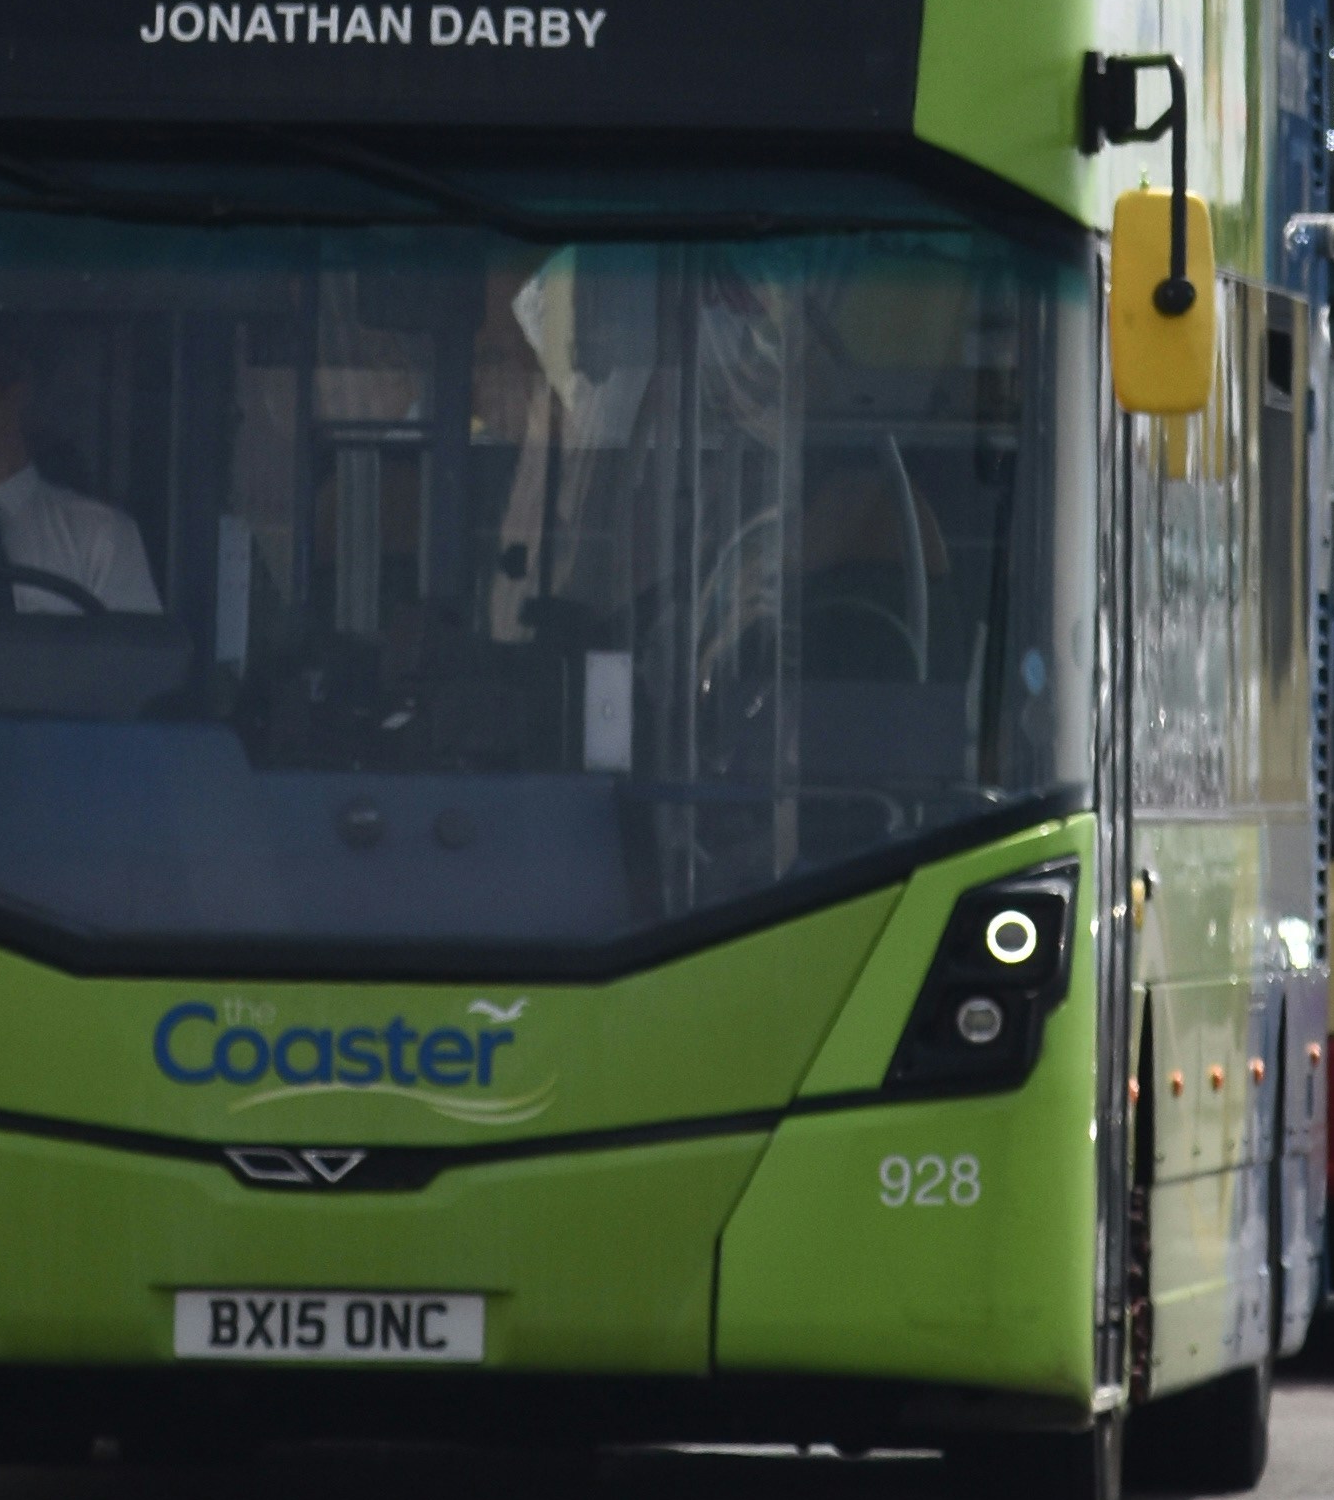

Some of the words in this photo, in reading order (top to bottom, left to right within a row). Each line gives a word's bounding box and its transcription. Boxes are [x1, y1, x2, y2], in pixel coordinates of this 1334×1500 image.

[139, 2, 413, 45] JONATHAN
[429, 5, 608, 49] DARBY
[153, 1000, 516, 1088] Coaster
[879, 1153, 982, 1207] 928
[208, 1299, 327, 1349] BX15
[344, 1301, 447, 1351] ONC
